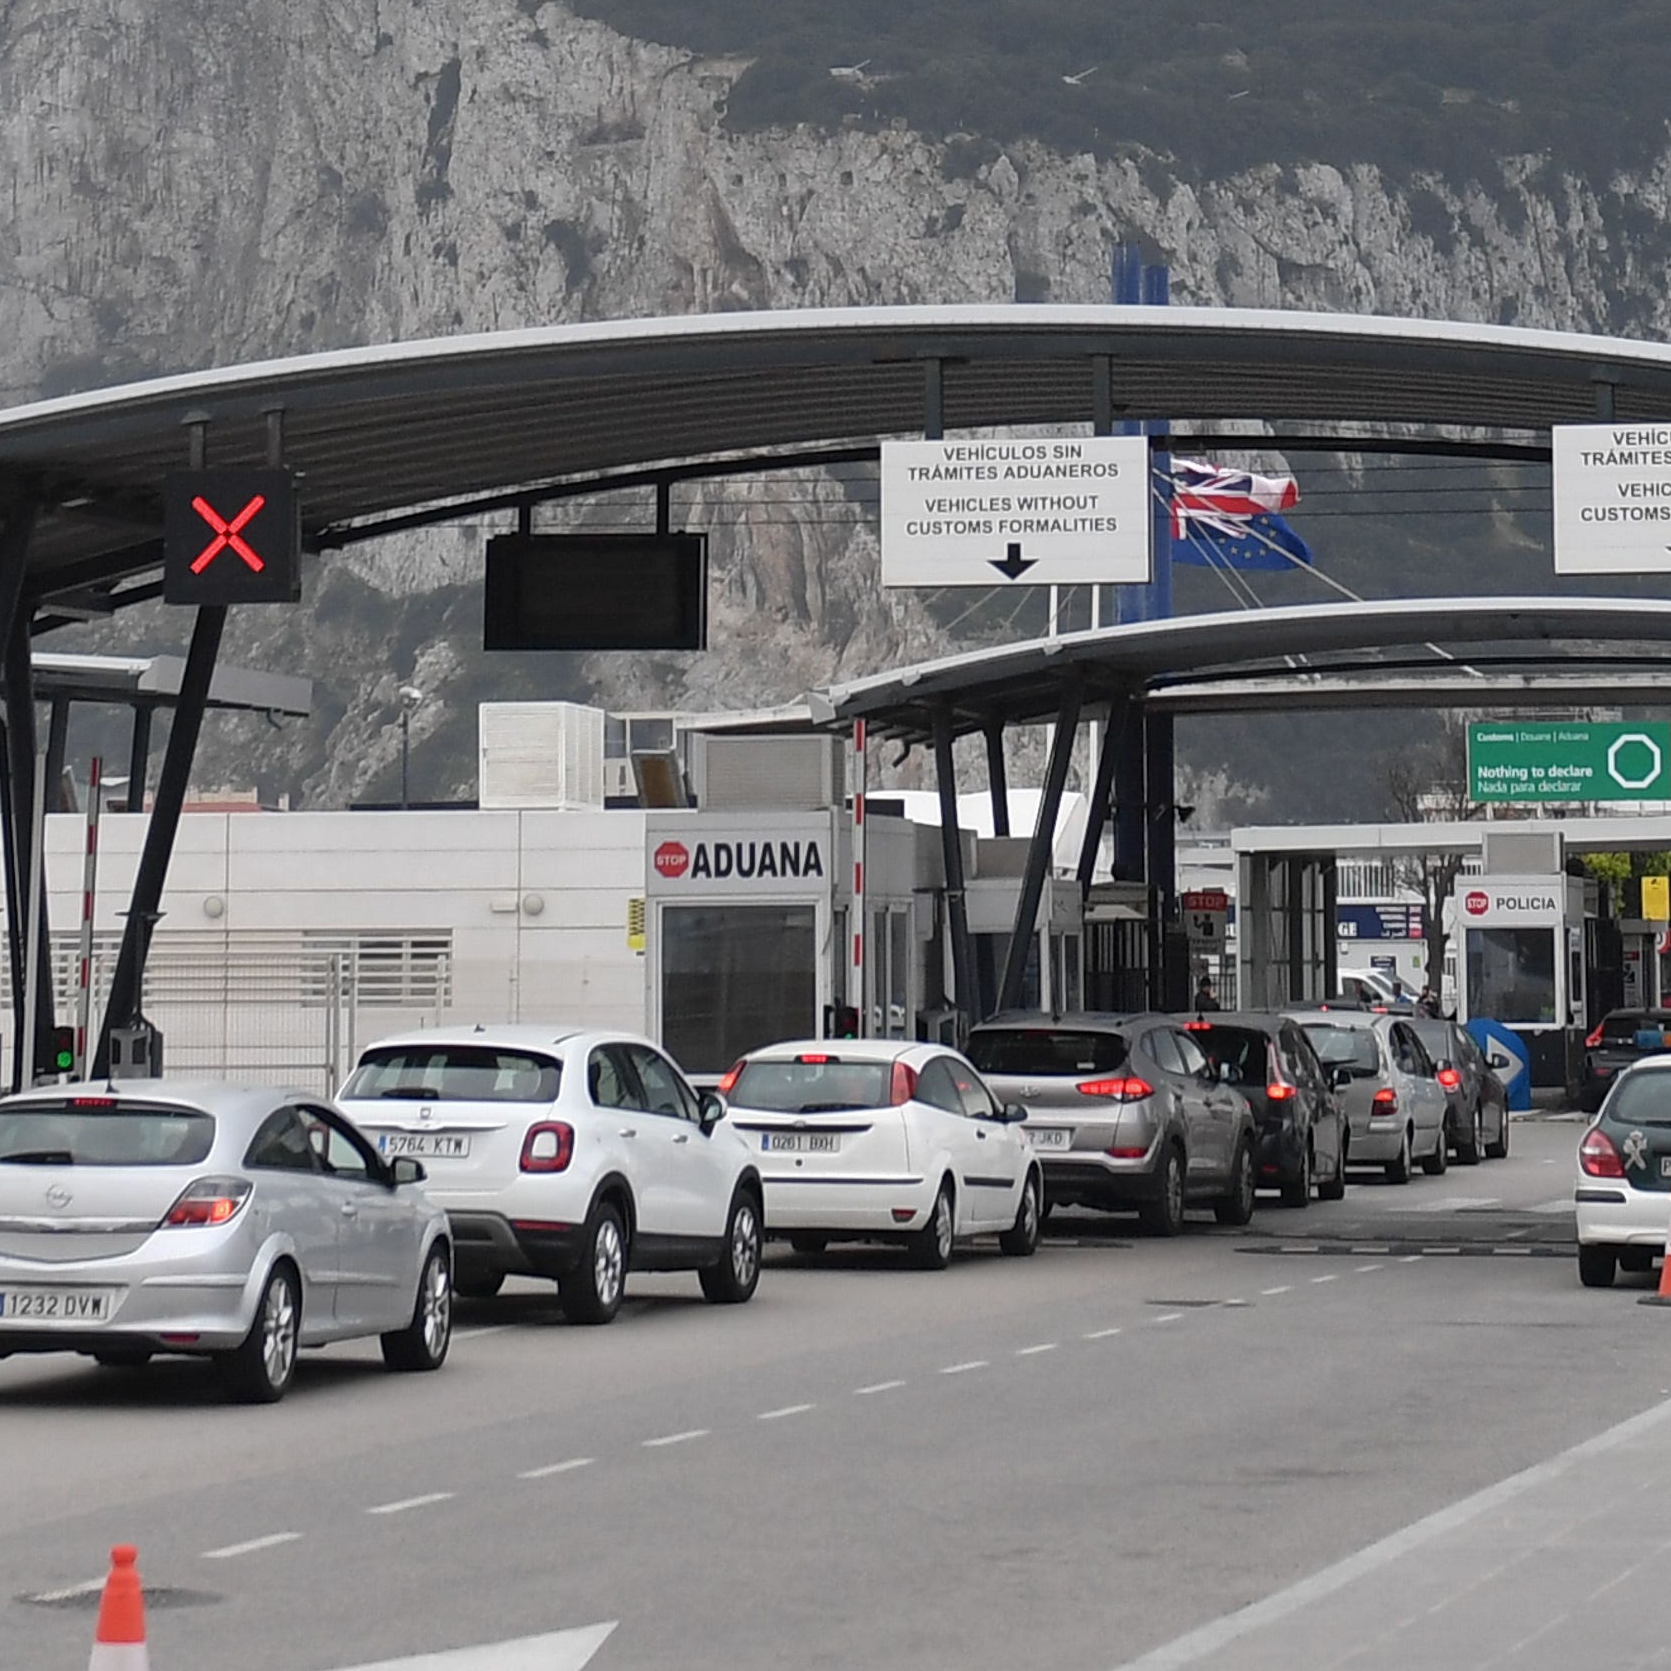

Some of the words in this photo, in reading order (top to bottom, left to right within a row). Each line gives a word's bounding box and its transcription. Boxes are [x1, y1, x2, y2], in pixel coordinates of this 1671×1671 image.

[943, 444, 1047, 461] VEHÍCULOS
[1052, 444, 1082, 459] SIN
[908, 464, 998, 481] TRÁMITES
[1004, 463, 1119, 479] ADUANEROS
[925, 497, 1012, 512] VEHICLES
[1018, 495, 1099, 510] WITHOUT
[1581, 506, 1671, 522] CUSTOMS
[906, 520, 993, 535] CUSTOMS
[999, 517, 1117, 533] FORMALITIES
[1478, 764, 1528, 781] Nothing
[1532, 766, 1545, 778] to
[1548, 764, 1593, 777] declare
[1477, 780, 1507, 793] Nada
[1511, 783, 1535, 795] para
[1538, 780, 1581, 792] declarar
[657, 854, 686, 866] STOP
[691, 841, 823, 879] ADUANA
[1467, 898, 1487, 909] STOP
[1496, 897, 1556, 910] POLICIA
[11, 1295, 58, 1315] 1232
